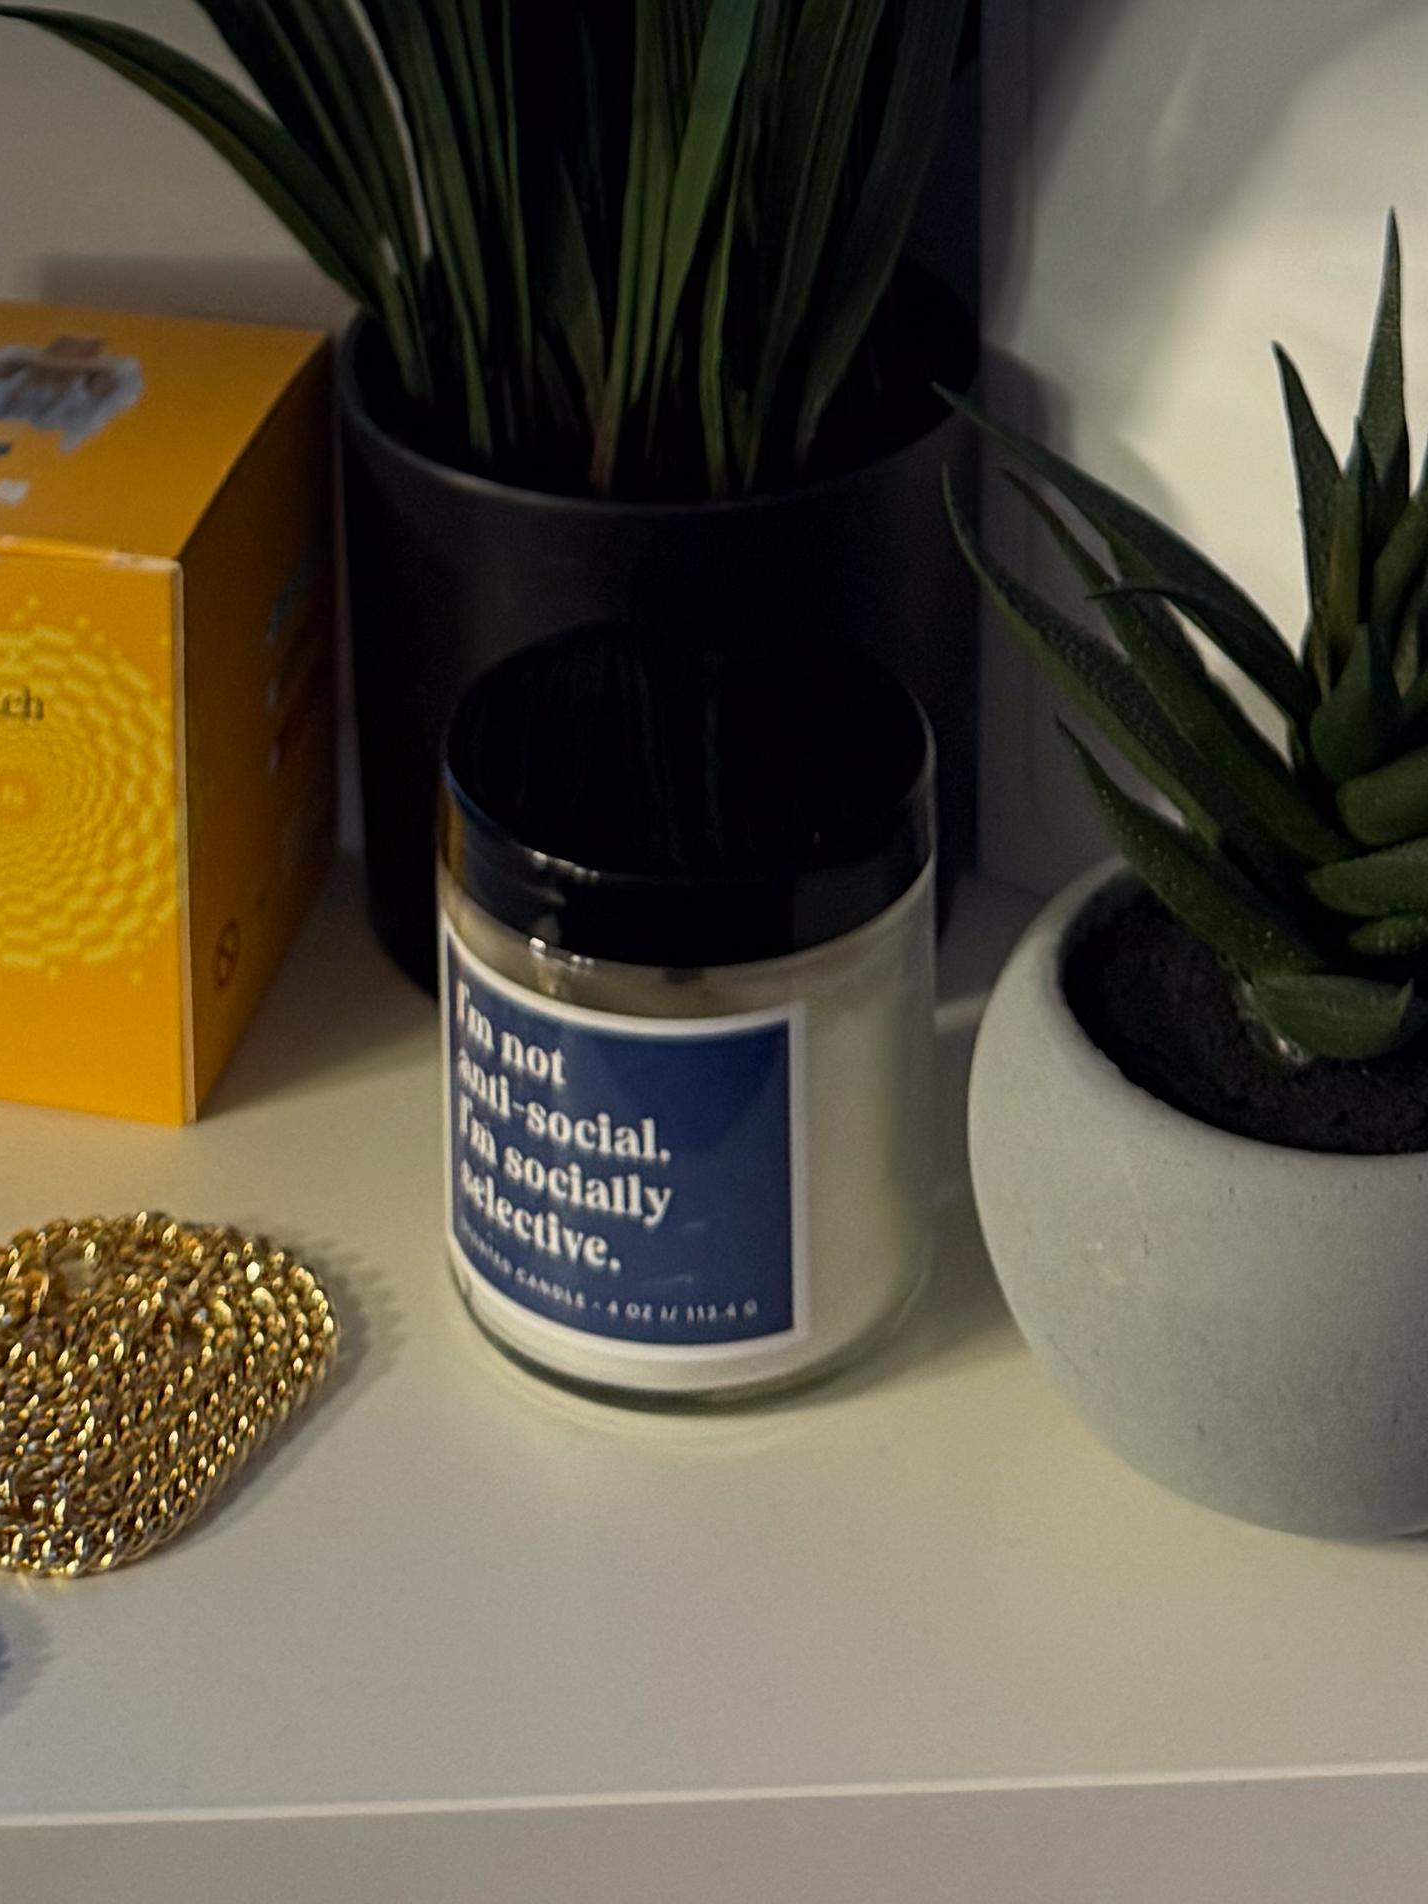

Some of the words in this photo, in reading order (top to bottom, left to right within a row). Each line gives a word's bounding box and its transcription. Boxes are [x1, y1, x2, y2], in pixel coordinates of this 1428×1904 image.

[500, 1030, 567, 1087] not
[457, 1047, 672, 1164] anti-social.
[460, 1158, 621, 1273] selective.
[503, 1145, 672, 1229] socially
[514, 1266, 586, 1310] CANDLE
